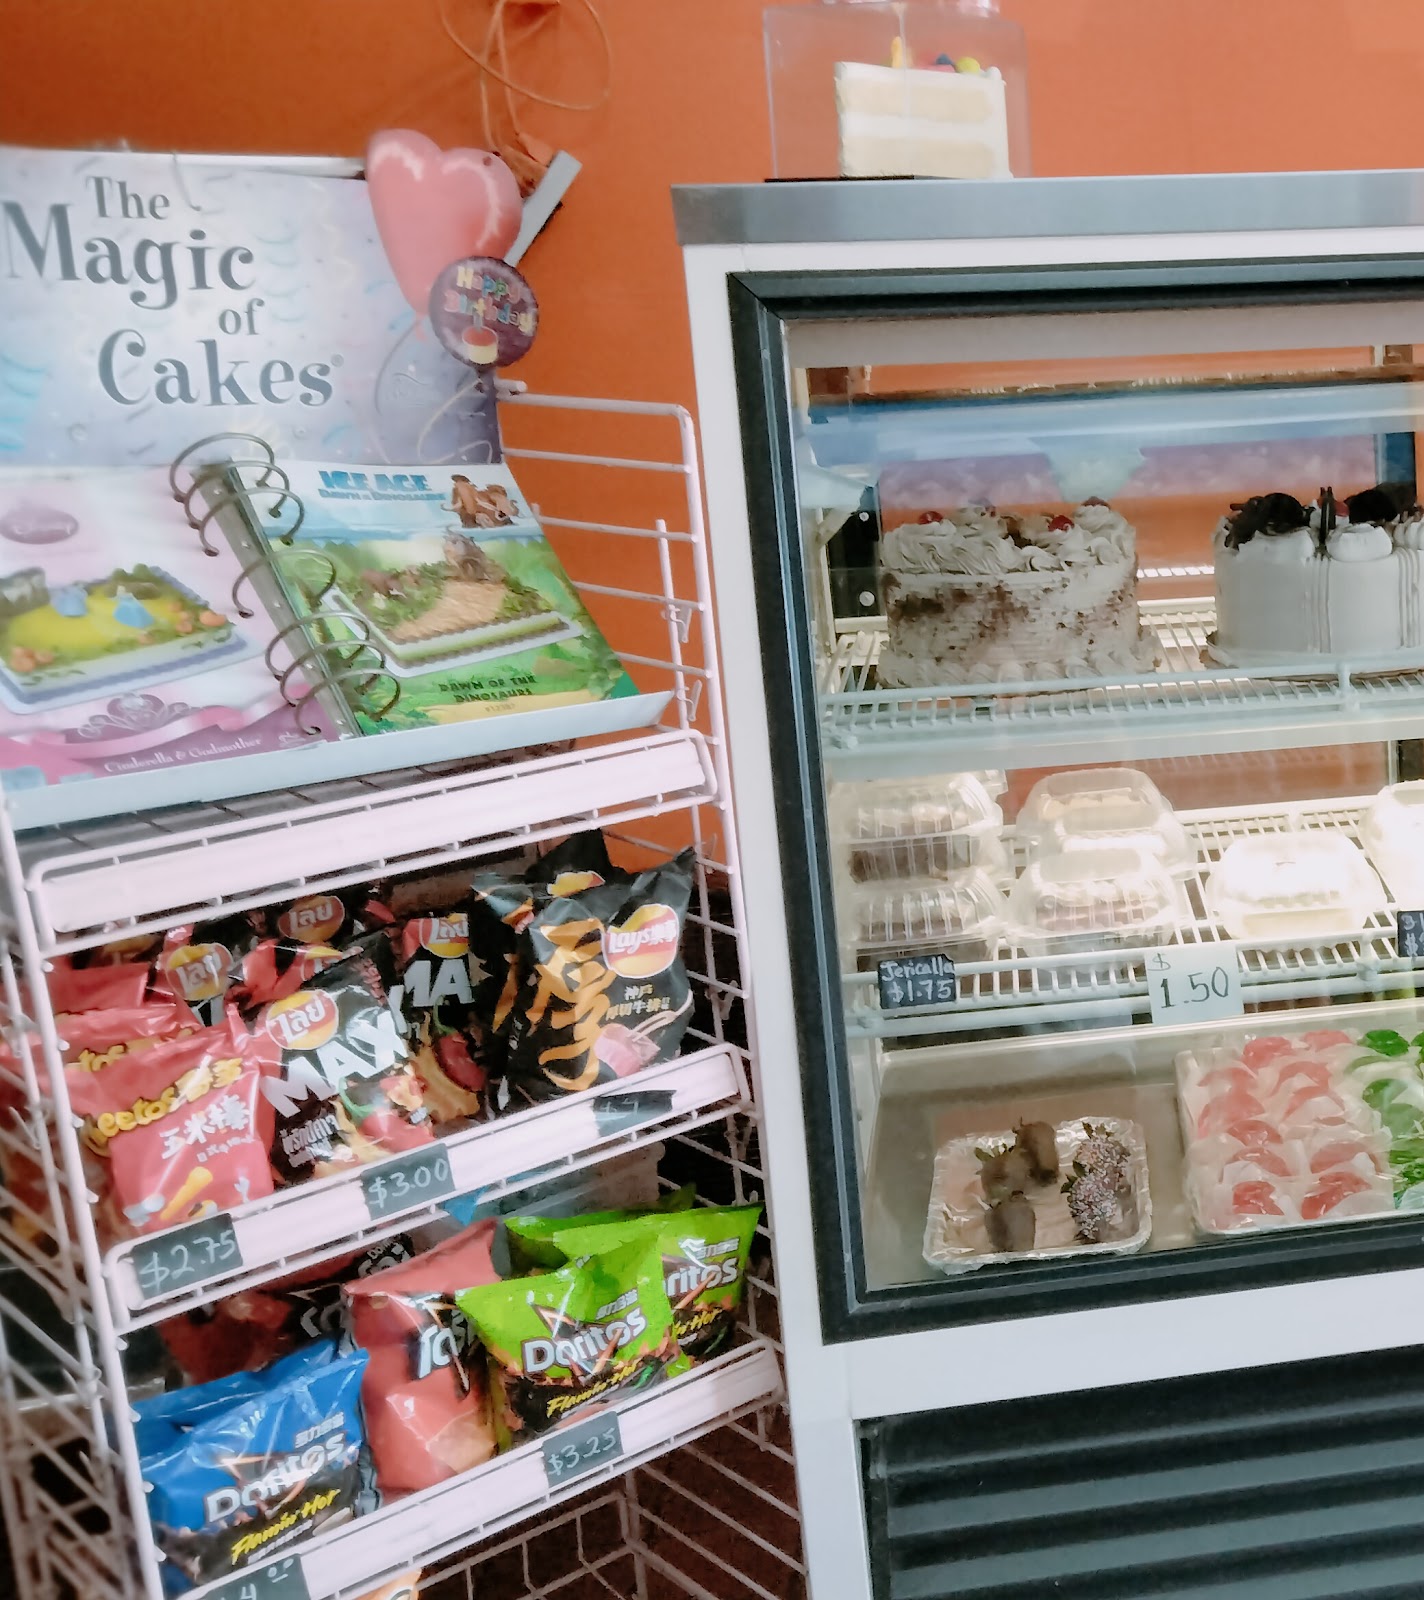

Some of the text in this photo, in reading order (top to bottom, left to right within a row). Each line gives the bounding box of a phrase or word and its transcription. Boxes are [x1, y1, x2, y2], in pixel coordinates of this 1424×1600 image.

[85, 175, 171, 221] The
[2, 200, 256, 311] Magic
[218, 297, 265, 336] of
[98, 328, 334, 407] Cakes
[318, 470, 432, 492] ICE AGE
[1401, 913, 1418, 931] 3
[879, 955, 956, 982] Jericalla
[887, 979, 955, 1003] $1.75
[260, 1010, 409, 1119] MAX
[366, 1159, 450, 1209] $3.00
[139, 1228, 238, 1294] $2.75
[663, 1257, 739, 1297] ritos
[522, 1305, 648, 1374] Doritos
[205, 1432, 346, 1523] Doritos
